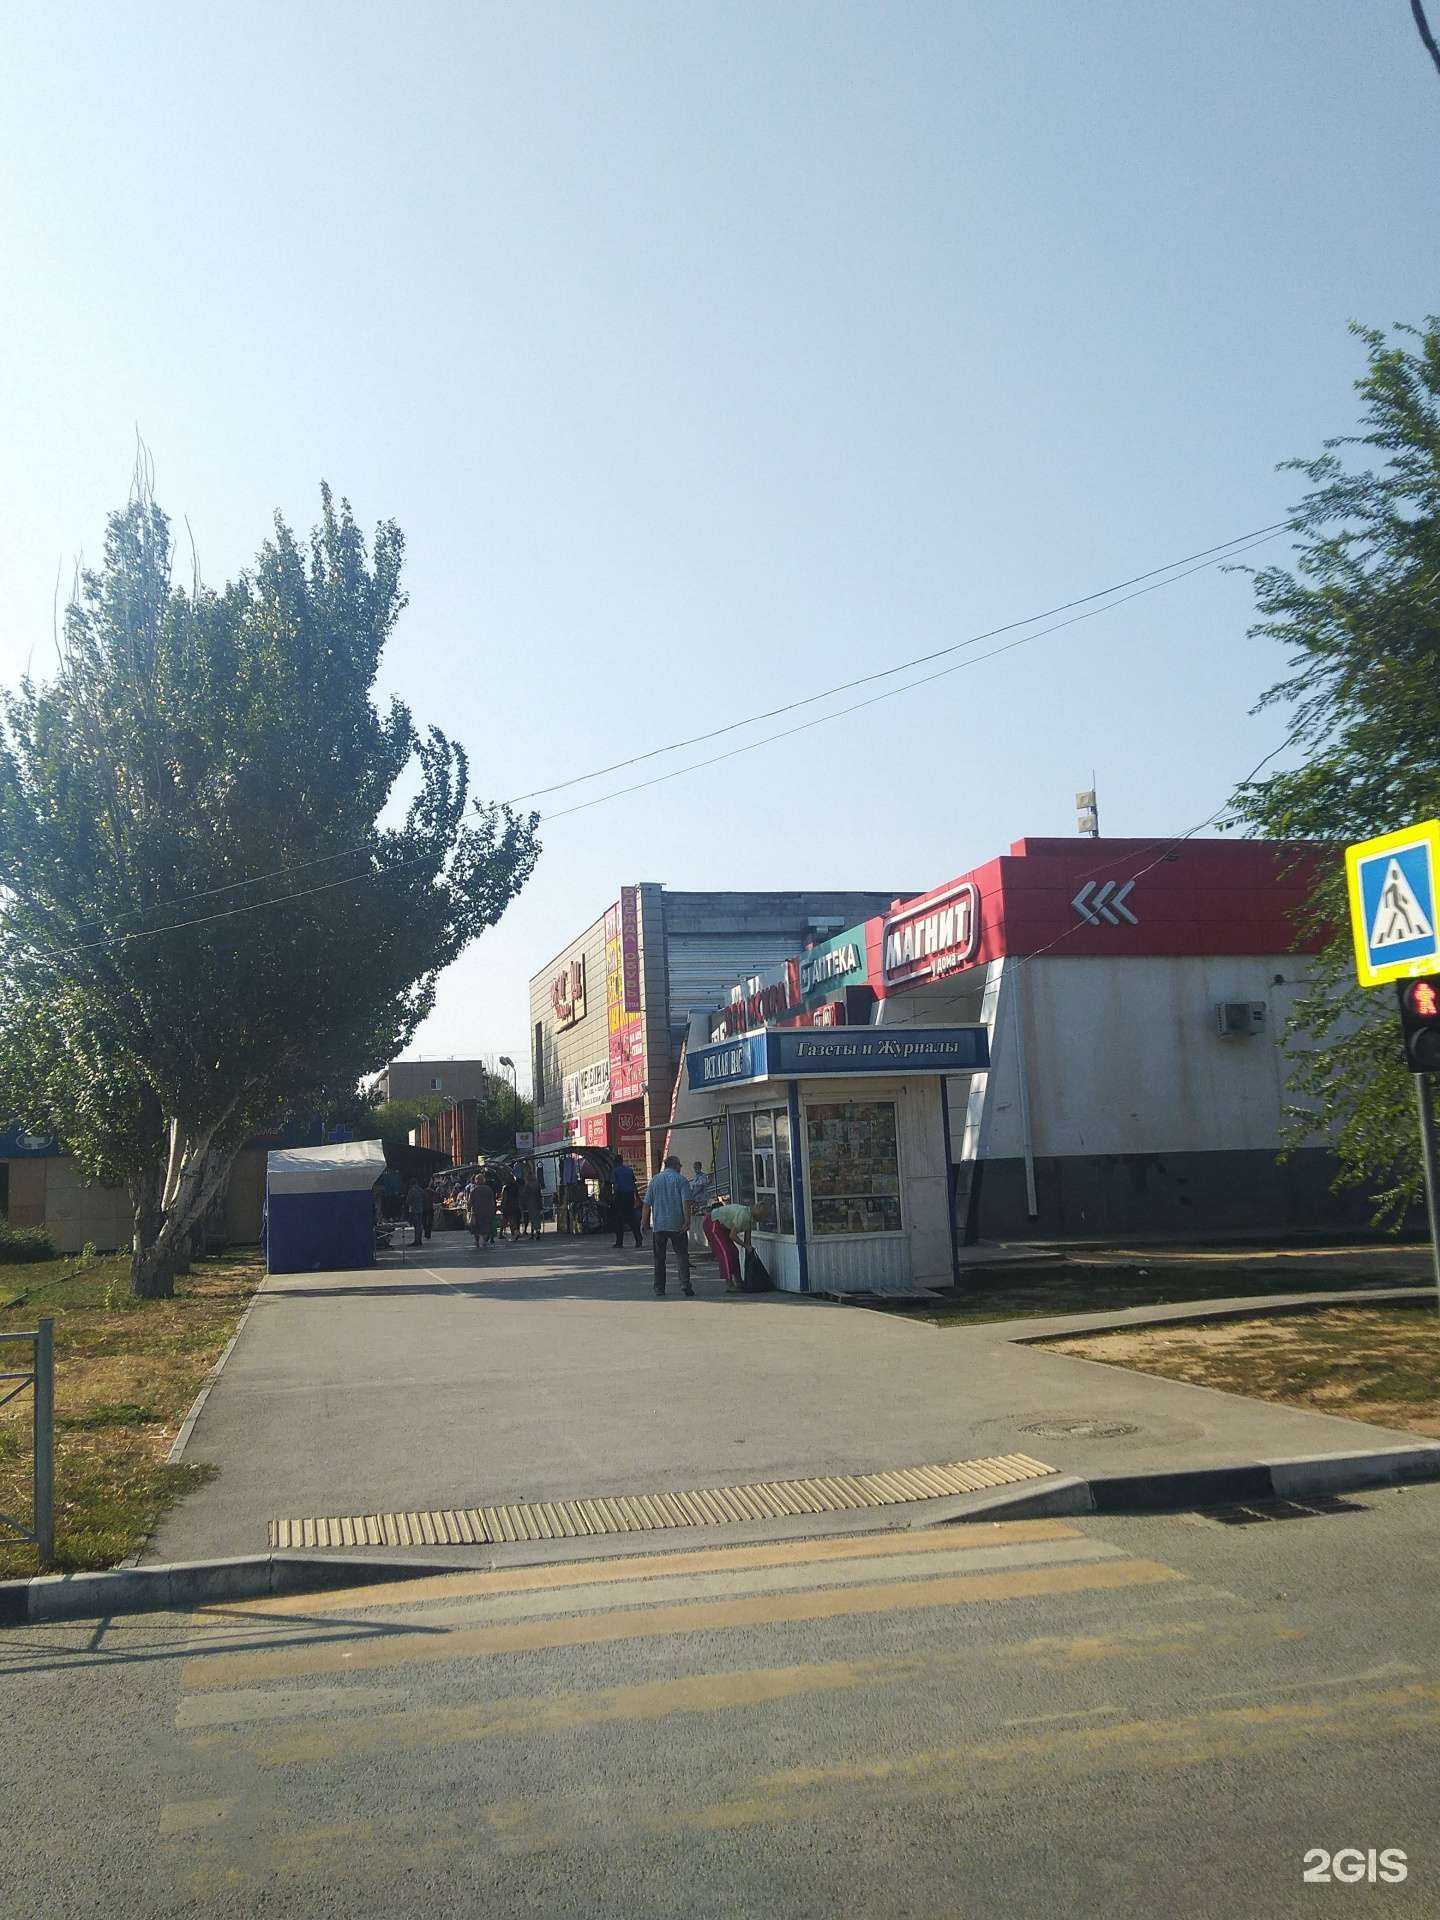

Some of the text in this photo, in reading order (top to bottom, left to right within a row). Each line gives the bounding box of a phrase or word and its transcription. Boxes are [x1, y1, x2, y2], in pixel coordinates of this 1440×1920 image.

[886, 900, 970, 972] МАГНИТ
[813, 943, 859, 982] АПТЕКА
[797, 1039, 959, 1058] Газеты и Журналы
